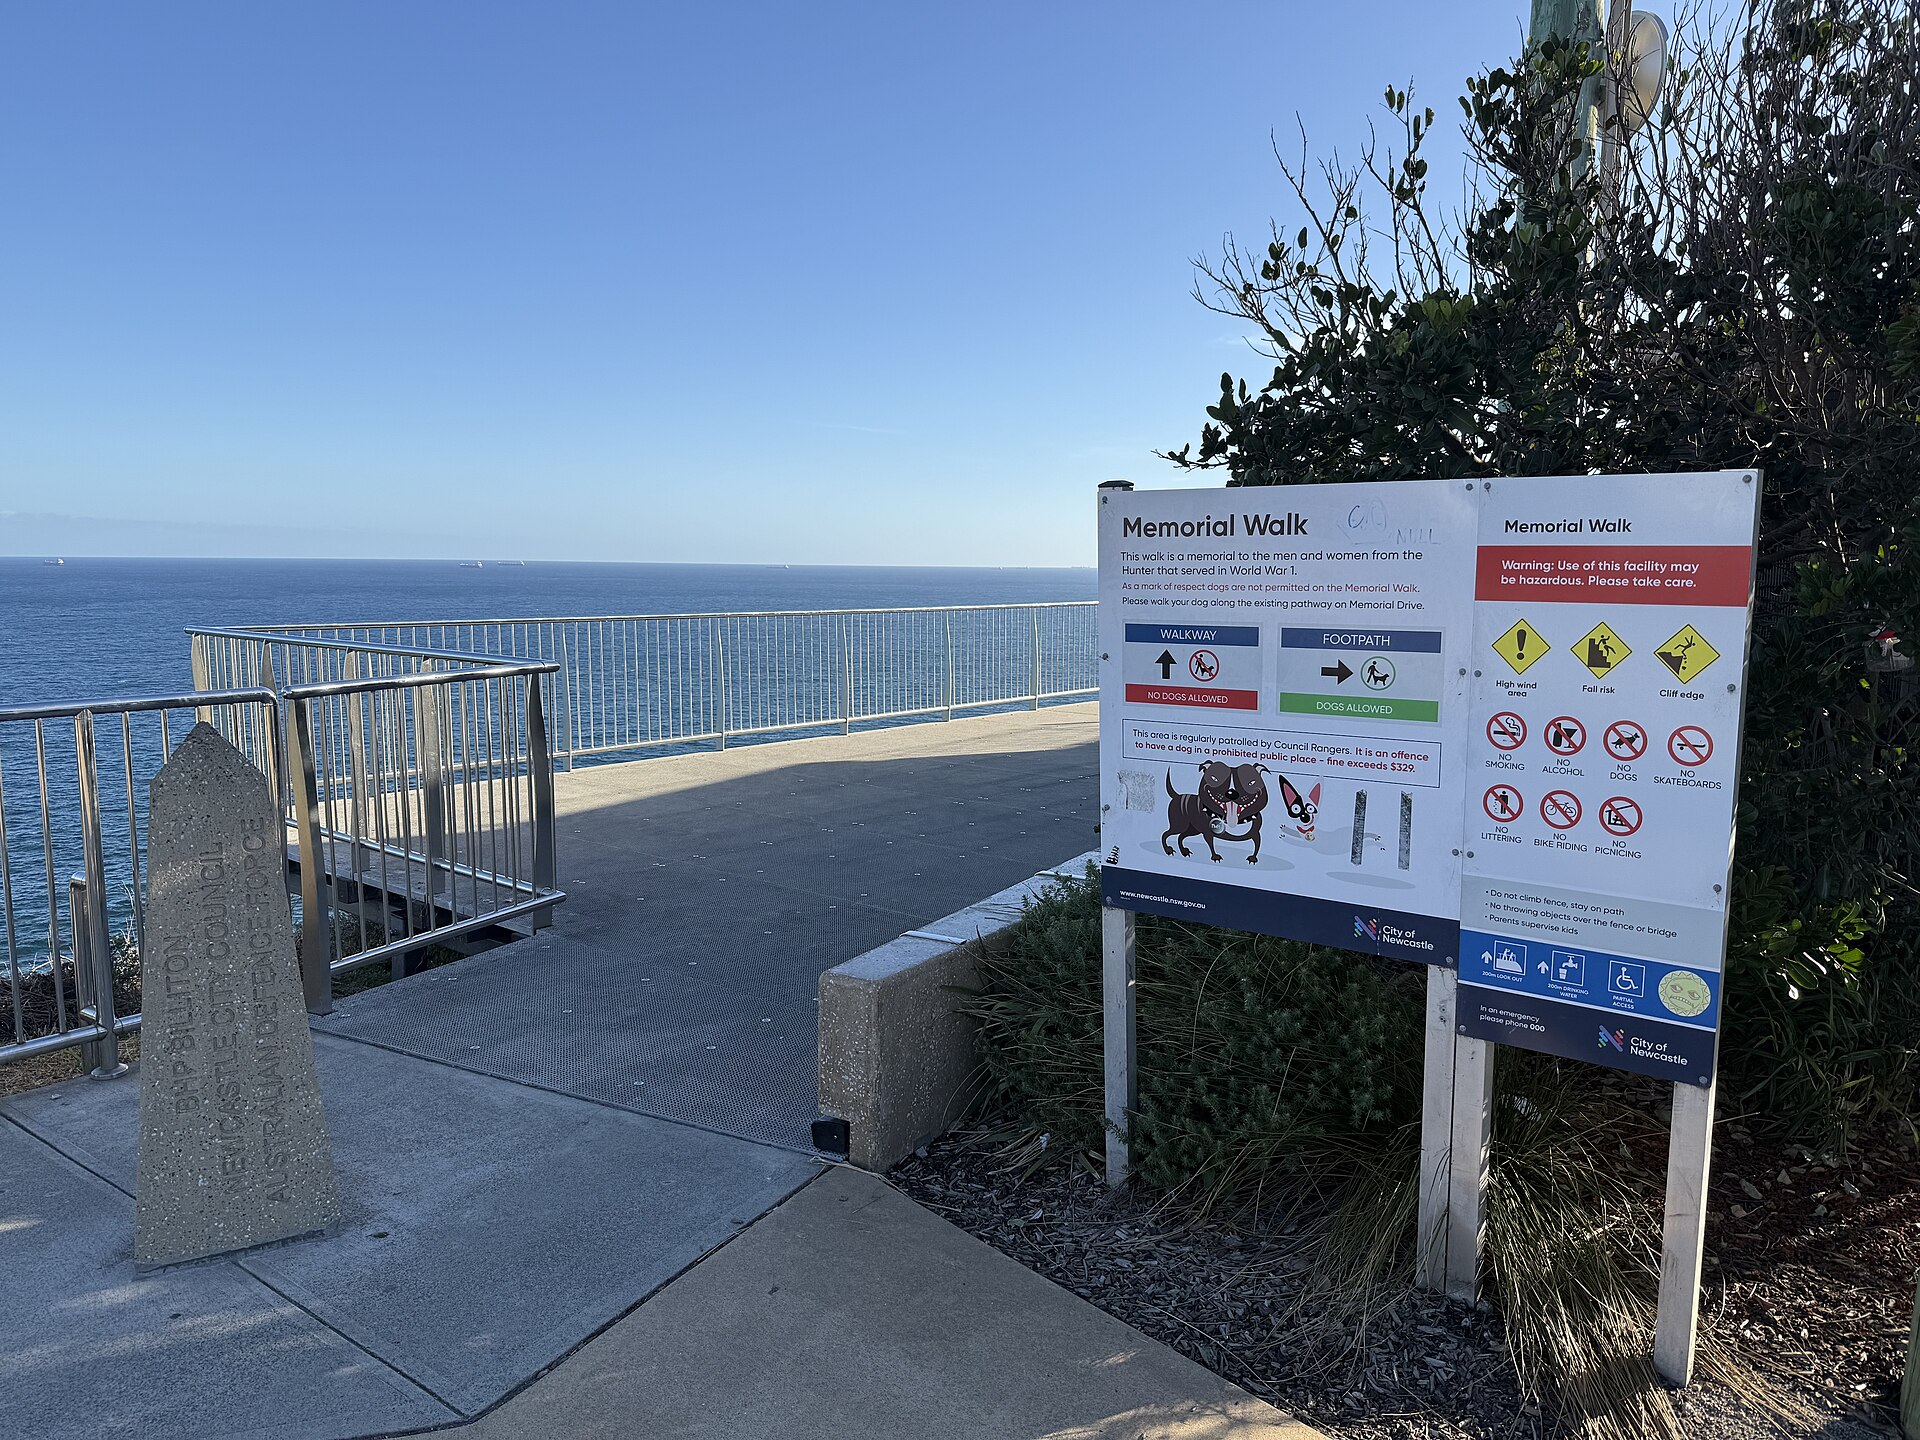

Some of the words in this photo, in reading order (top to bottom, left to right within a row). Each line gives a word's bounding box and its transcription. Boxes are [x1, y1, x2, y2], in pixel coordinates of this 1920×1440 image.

[1122, 514, 1235, 538] Memorial
[1243, 513, 1309, 537] Walk
[1504, 519, 1583, 533] Memorial
[1589, 518, 1632, 533] Walk
[1121, 552, 1140, 561] This
[1142, 552, 1164, 561] walk
[1167, 552, 1174, 561] is
[1187, 551, 1235, 561] memorial
[1238, 552, 1250, 561] to
[1252, 551, 1270, 561] the
[1273, 552, 1297, 560] men
[1300, 551, 1322, 561] and
[1326, 552, 1368, 560] women
[1372, 550, 1399, 560] from
[1402, 550, 1422, 560] the
[1122, 566, 1154, 575] Hunter
[1157, 566, 1178, 575] that
[1181, 566, 1215, 575] served
[1218, 566, 1226, 575] in
[1230, 566, 1262, 575] World
[1265, 566, 1287, 575] War
[1290, 566, 1298, 575] 1.
[1502, 560, 1554, 573] Warning:
[1558, 561, 1579, 571] Use
[1582, 560, 1596, 571] of
[1598, 560, 1620, 571] this
[1624, 561, 1667, 574] facility
[1670, 563, 1699, 574] may
[1164, 582, 1172, 590] of
[1174, 583, 1205, 592] respect
[1207, 583, 1229, 592] dogs
[1265, 583, 1310, 593] permitted
[1327, 584, 1342, 592] the
[1345, 584, 1389, 592] Memorial
[1393, 584, 1420, 593] Walk.
[1501, 575, 1516, 585] be
[1519, 575, 1584, 586] hazardous.
[1588, 576, 1629, 586] Please
[1632, 577, 1660, 587] take
[1122, 597, 1149, 605] Please
[1171, 599, 1189, 607] your
[1191, 598, 1208, 608] dog
[1211, 599, 1235, 608] along
[1254, 599, 1288, 609] existing
[1291, 600, 1331, 610] pathway
[1350, 600, 1394, 609] Memorial
[1397, 601, 1424, 610] Drive.
[1160, 629, 1217, 641] WALKWAY
[1322, 634, 1391, 647] FOOTPATH
[1496, 680, 1515, 690] High
[1582, 685, 1598, 693] Fall
[1600, 686, 1615, 694] risk
[1147, 692, 1160, 701] NO
[1162, 692, 1184, 702] DOGS
[1186, 694, 1228, 704] ALLOWED
[1660, 690, 1678, 698] Cliff
[1680, 691, 1705, 700] edge
[1316, 702, 1343, 712] DOGS
[1344, 703, 1392, 715] ALLOWED
[1133, 729, 1148, 738] This
[1172, 732, 1178, 740] is
[1180, 733, 1216, 745] regularly
[1218, 736, 1258, 747] patrolled
[1261, 739, 1272, 749] by
[1274, 741, 1308, 750] Council
[1311, 743, 1352, 755] Rangers.
[1355, 747, 1362, 755] It
[1365, 748, 1372, 756] is
[1391, 750, 1428, 761] offence
[1146, 742, 1166, 750] have
[1176, 744, 1192, 754] dog
[1195, 746, 1201, 754] in
[1212, 748, 1257, 759] prohibited
[1260, 752, 1288, 761] public
[1290, 754, 1316, 763] place
[1327, 757, 1344, 766] fine
[1347, 760, 1387, 770] exceeds
[1390, 762, 1415, 773] $329.
[1485, 761, 1525, 771] SMOKING
[1542, 766, 1584, 776] ALCOHOL
[1610, 772, 1637, 781] DOGS
[1653, 776, 1722, 790] SKATEBOARDS
[1482, 833, 1522, 844] LITTERING
[1534, 839, 1554, 848] BIKE
[1556, 842, 1587, 852] RIDING
[1595, 847, 1642, 859] PICNICING
[241, 817, 269, 908] FORCE
[200, 842, 230, 960] COUNCIL
[1120, 890, 1206, 909] www.newcastle.nsw.gov.au
[1504, 892, 1517, 900] not
[1520, 894, 1541, 903] climb
[1544, 898, 1568, 908] fence,
[1571, 902, 1589, 912] stay
[1604, 907, 1625, 916] path
[1489, 915, 1519, 925] Parents
[1522, 920, 1559, 932] supervise
[1562, 926, 1578, 935] kids
[1503, 904, 1538, 917] throwing
[1540, 910, 1571, 921] objects
[1573, 915, 1591, 924] over
[1594, 917, 1607, 927] the
[1610, 920, 1634, 930] fence
[1648, 927, 1677, 938] bridge
[1382, 925, 1402, 940] City
[1404, 928, 1416, 939] of
[1382, 934, 1434, 951] Newcastle
[248, 918, 278, 1036] DEFENCE
[164, 936, 195, 1050] BILLITON
[208, 969, 235, 1024] CITY
[1563, 986, 1589, 995] DRINKING
[1612, 995, 1634, 1004] PARTIAL
[1480, 1014, 1504, 1024] please
[1505, 1018, 1528, 1029] phone
[1529, 1024, 1545, 1032] 000
[1499, 1009, 1540, 1023] emergency
[1630, 1036, 1653, 1051] City
[1652, 1041, 1667, 1052] of
[1630, 1046, 1688, 1066] Newcastle
[174, 1061, 199, 1114] BHP
[213, 1033, 248, 1194] NEWCASTLE
[257, 1046, 289, 1202] AUSTRALIAN
